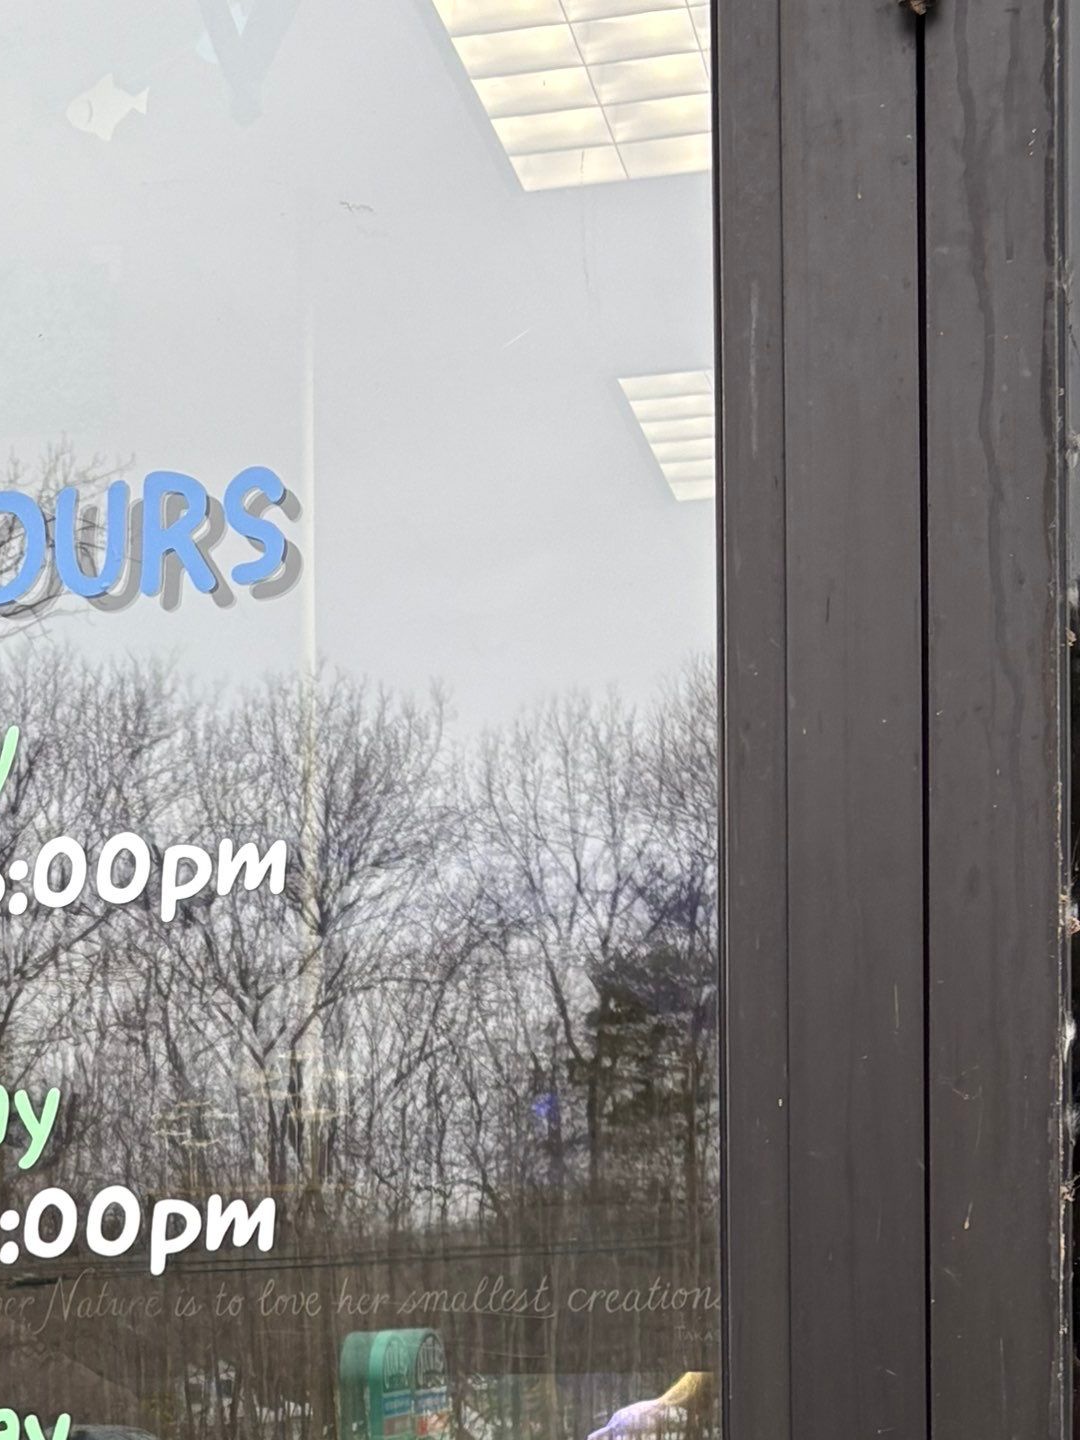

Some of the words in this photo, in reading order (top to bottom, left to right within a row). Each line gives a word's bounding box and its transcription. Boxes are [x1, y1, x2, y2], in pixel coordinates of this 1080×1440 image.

[33, 1268, 162, 1335] Nature
[174, 1289, 203, 1317] is
[215, 1281, 245, 1318] to
[258, 1278, 322, 1318] love
[336, 1276, 390, 1315] her
[397, 1274, 552, 1315] smallest
